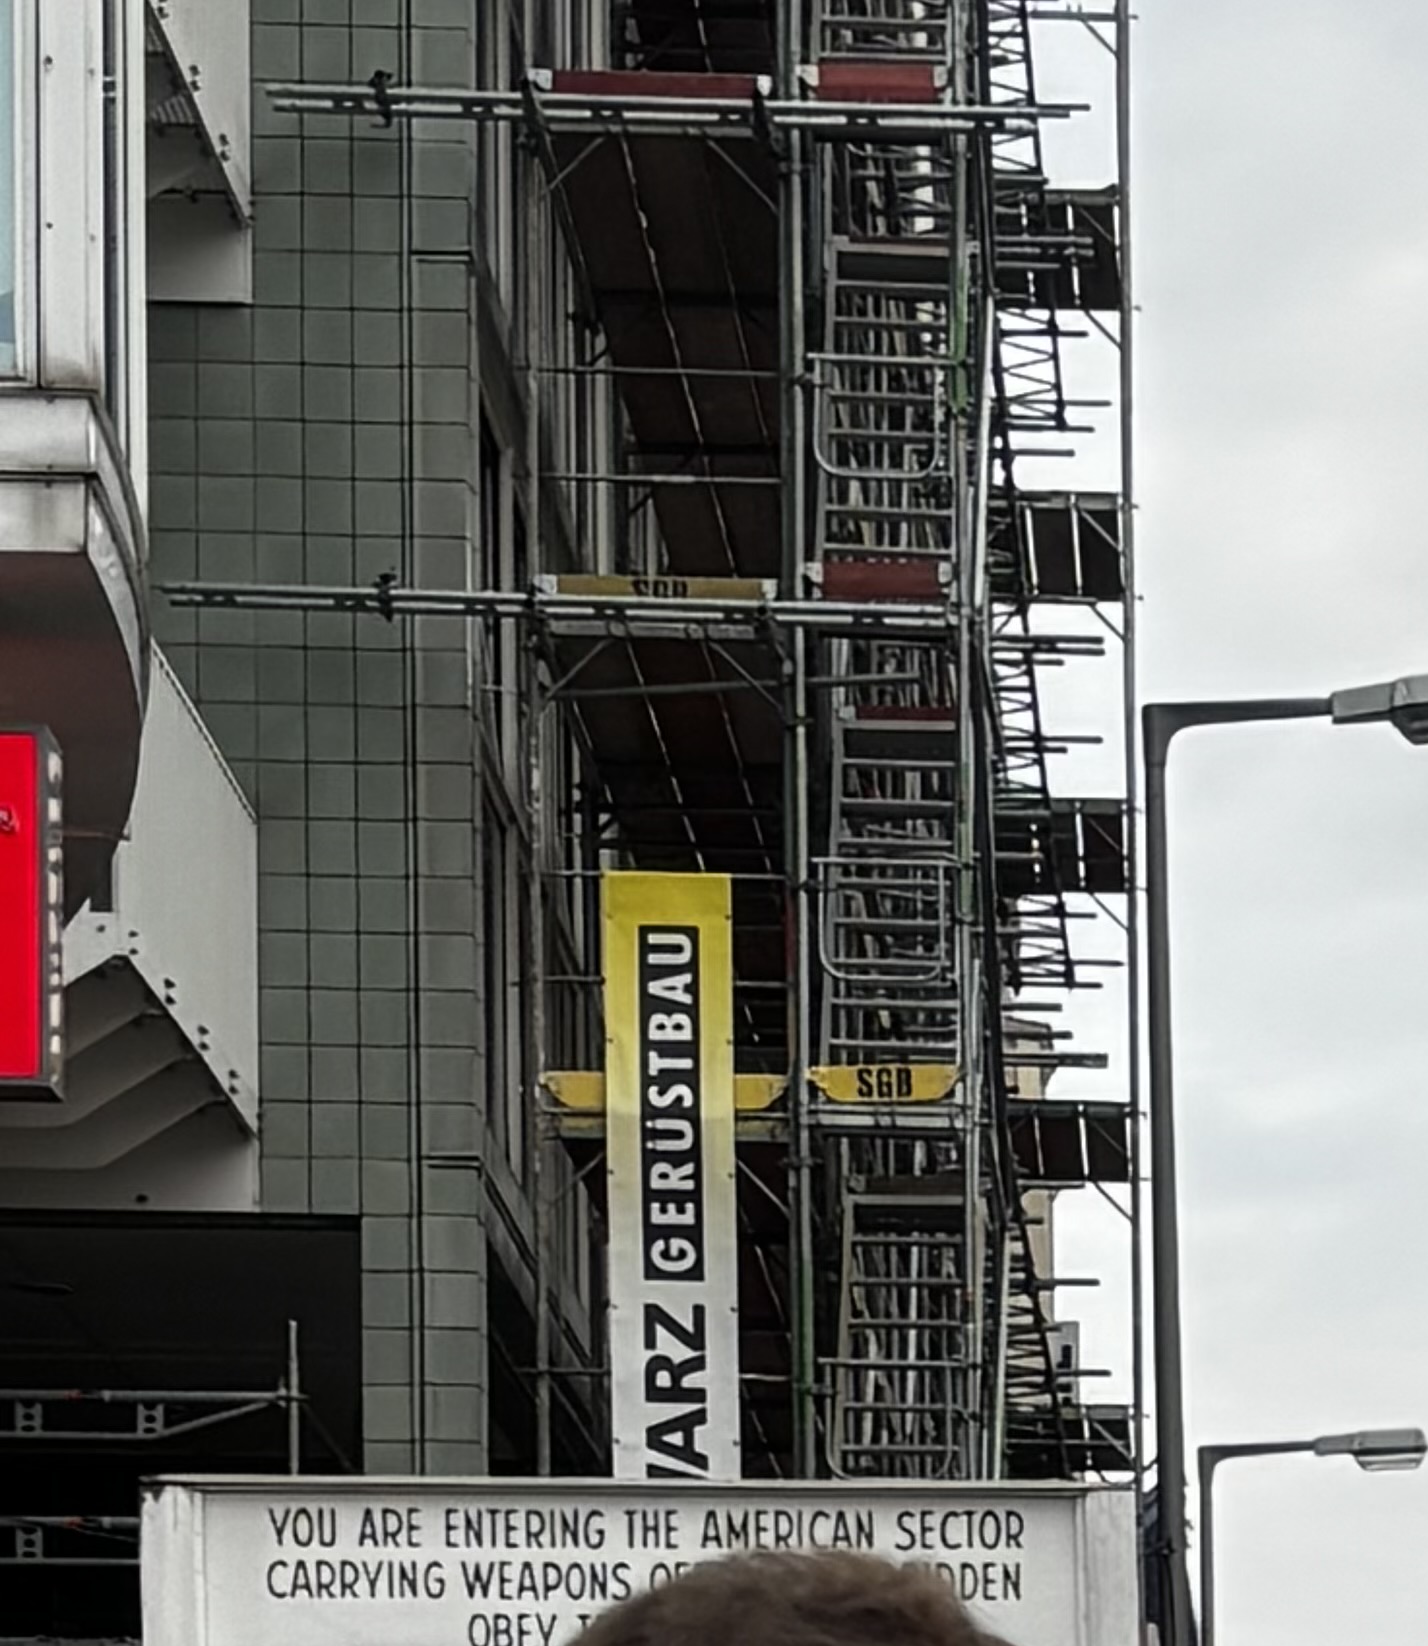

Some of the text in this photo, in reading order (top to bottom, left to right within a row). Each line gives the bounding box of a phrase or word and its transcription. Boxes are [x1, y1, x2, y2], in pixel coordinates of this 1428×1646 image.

[645, 931, 697, 1274] GERÜSTBAU
[856, 1066, 913, 1099] SGB
[268, 1507, 1025, 1551] YOU ARE ENTERING THE AMERICAN SECTOR
[267, 1560, 446, 1599] CARRYING
[460, 1561, 632, 1601] WEAPONS
